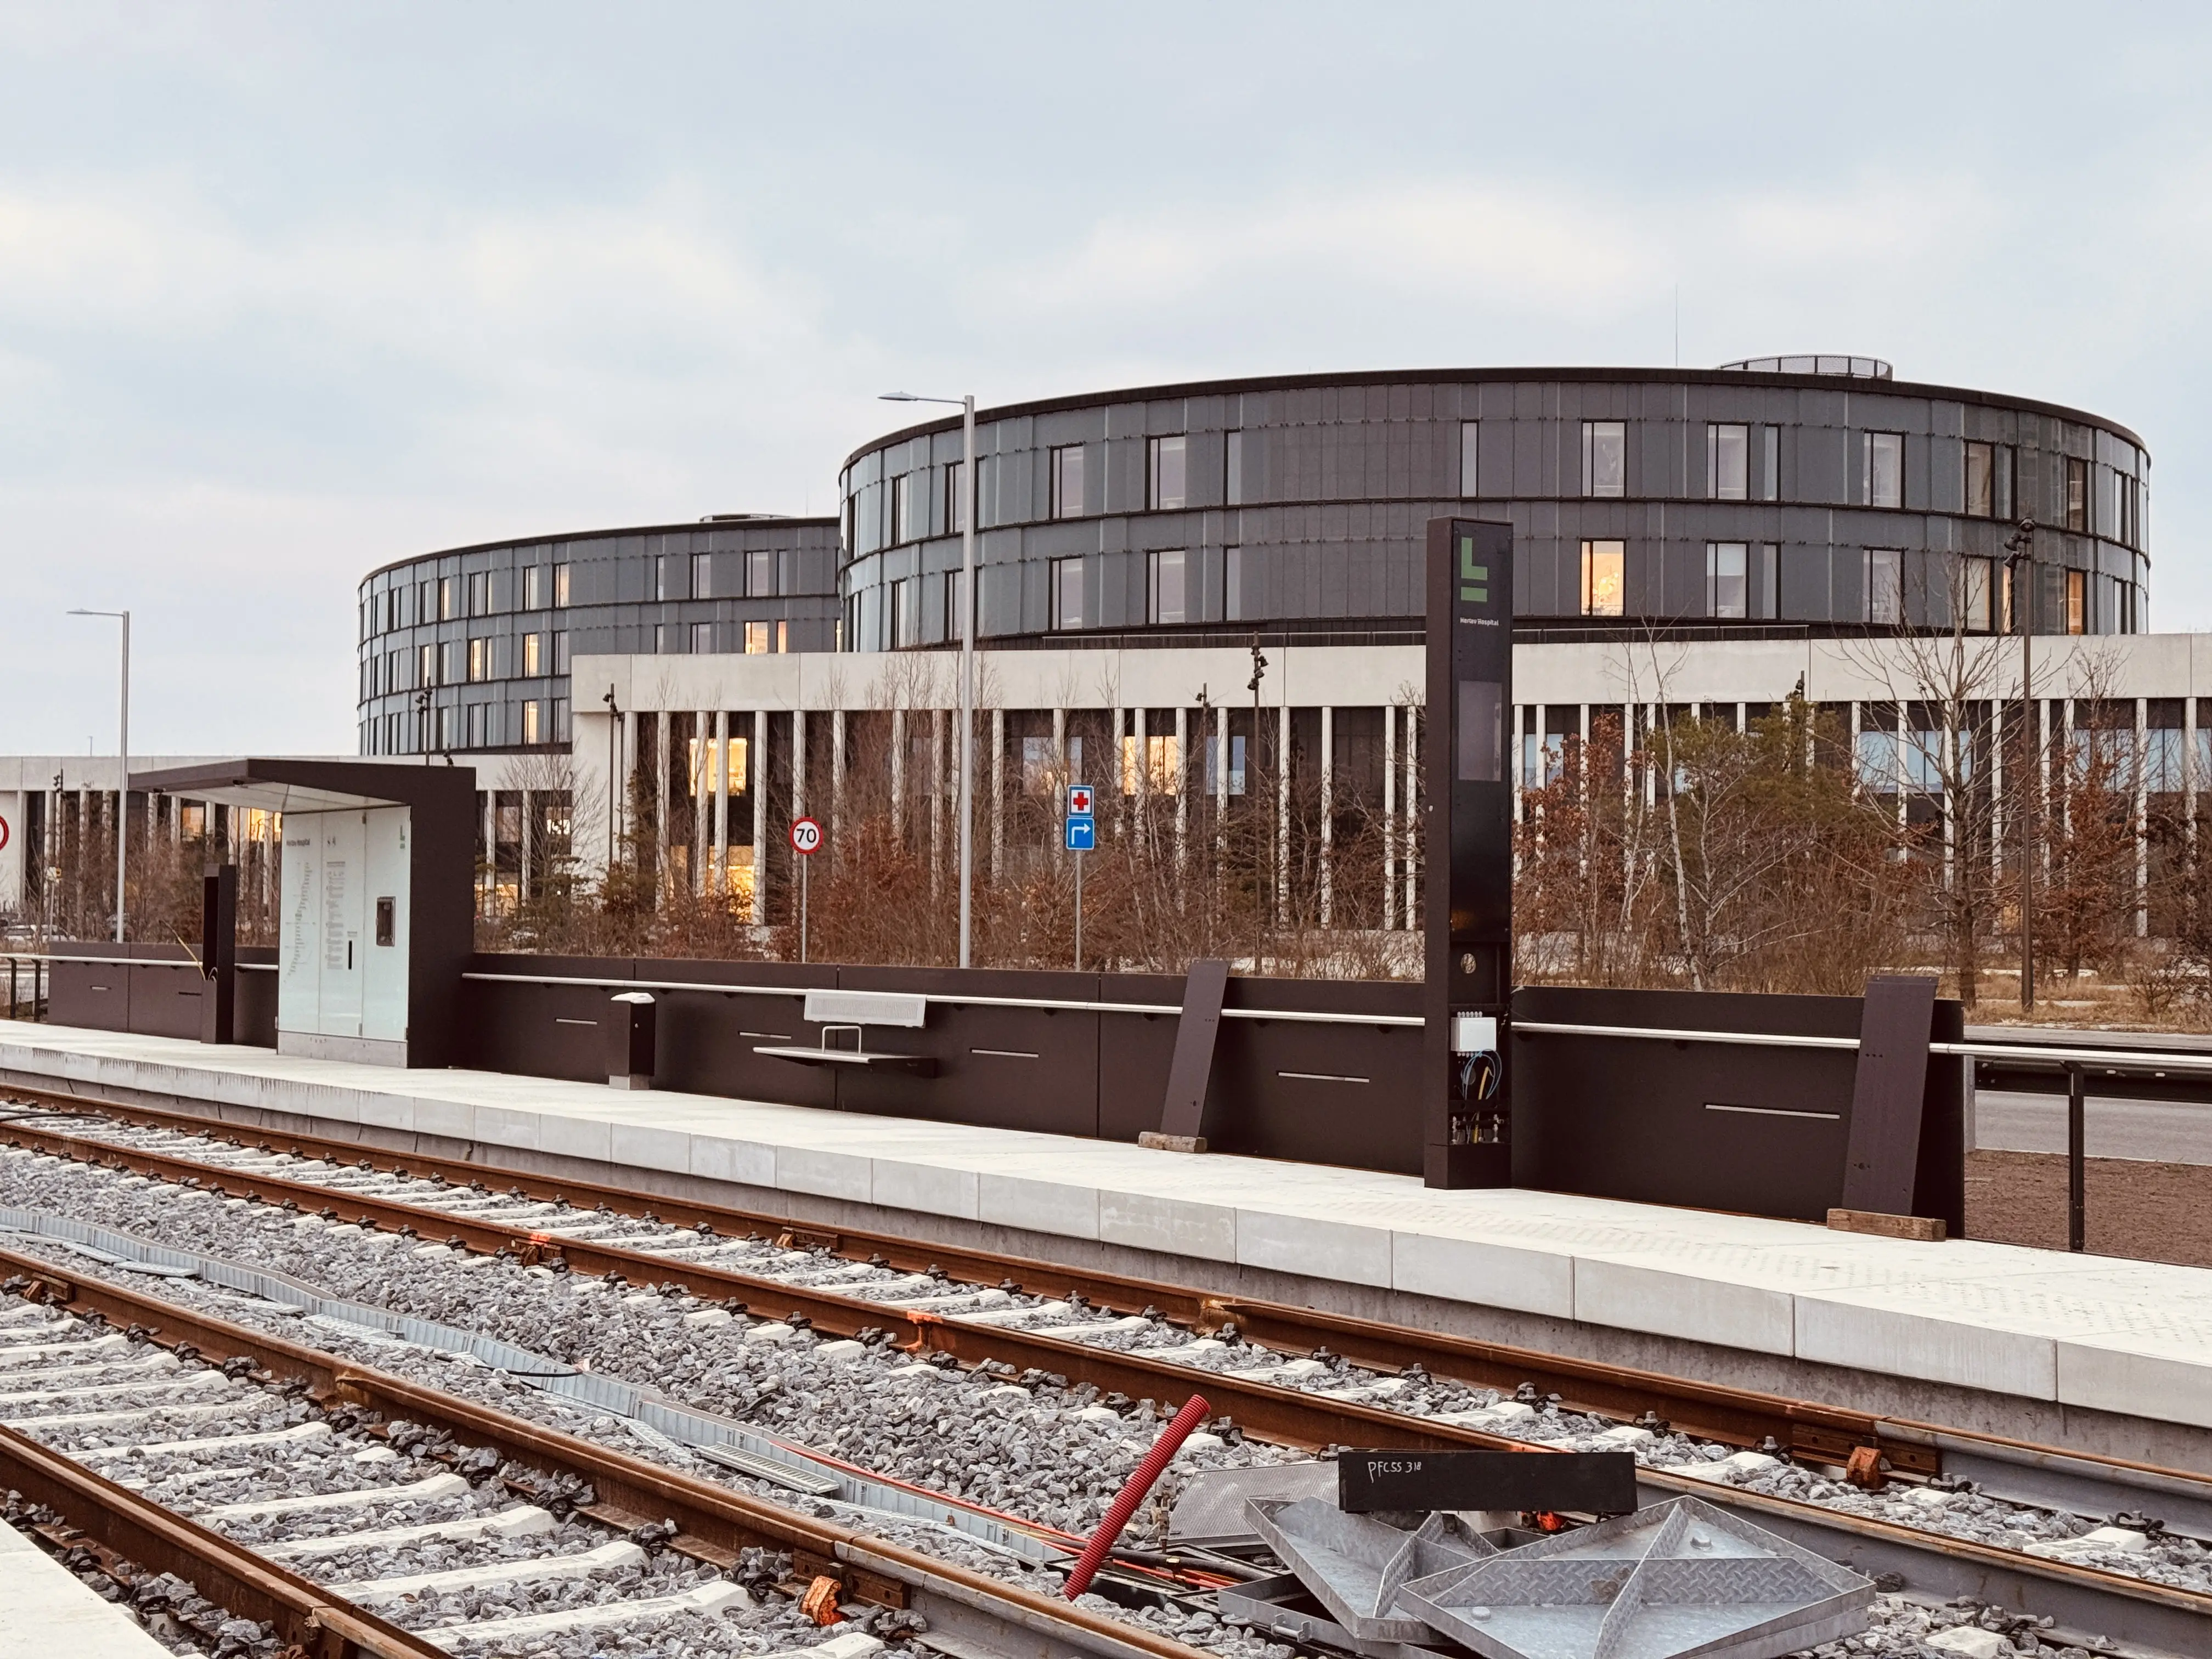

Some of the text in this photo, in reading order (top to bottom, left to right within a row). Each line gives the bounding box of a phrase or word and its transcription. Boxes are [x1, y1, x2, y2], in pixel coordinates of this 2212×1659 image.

[1477, 618, 1499, 627] Hospital
[797, 828, 816, 843] 70
[1404, 1462, 1421, 1473] 318
